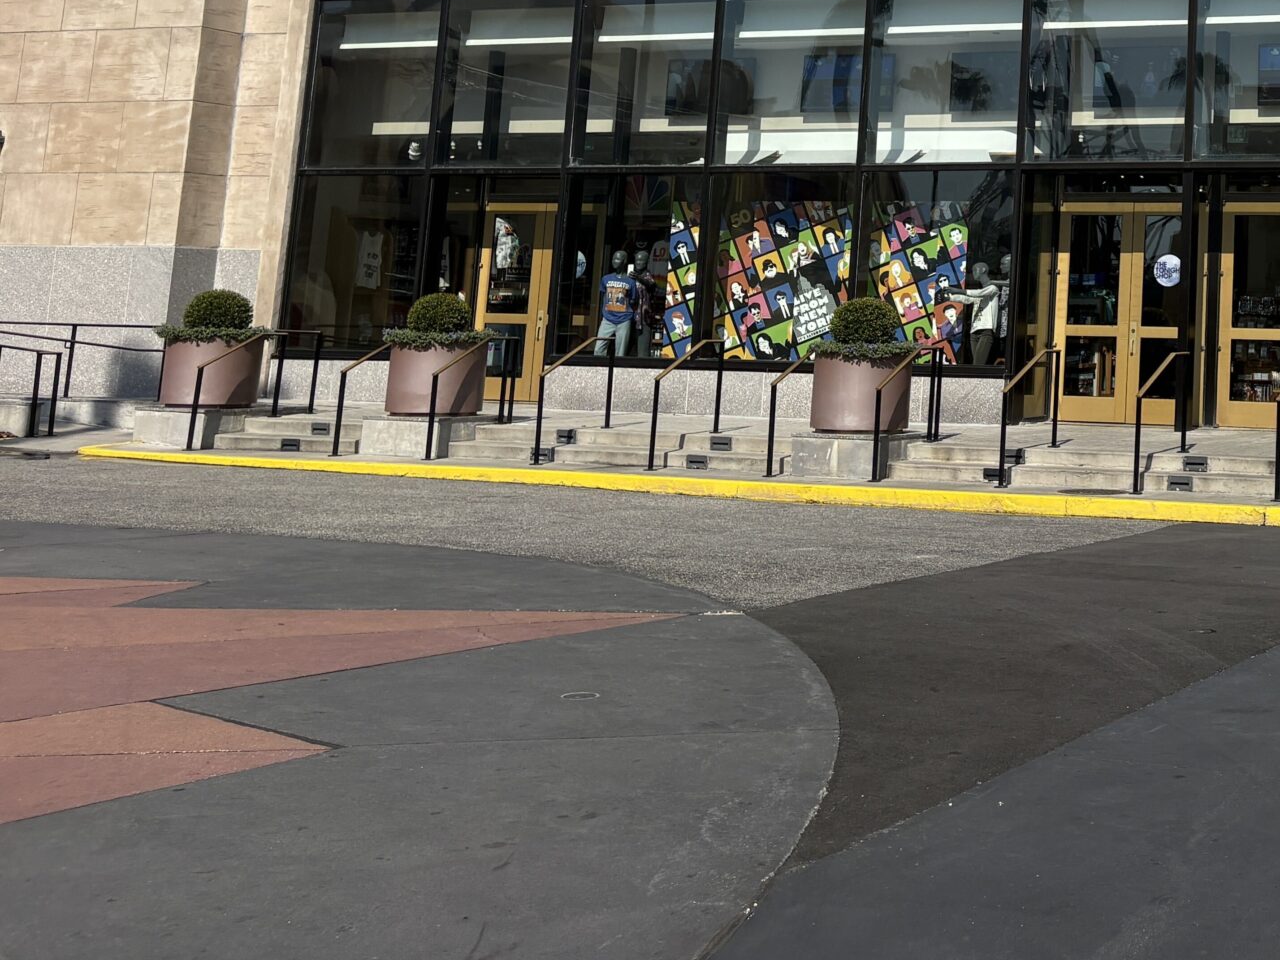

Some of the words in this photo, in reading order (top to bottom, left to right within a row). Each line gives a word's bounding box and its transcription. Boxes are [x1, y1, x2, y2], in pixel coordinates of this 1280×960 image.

[793, 295, 829, 317] FROM
[794, 287, 822, 307] LIVE
[798, 305, 827, 324] NEW
